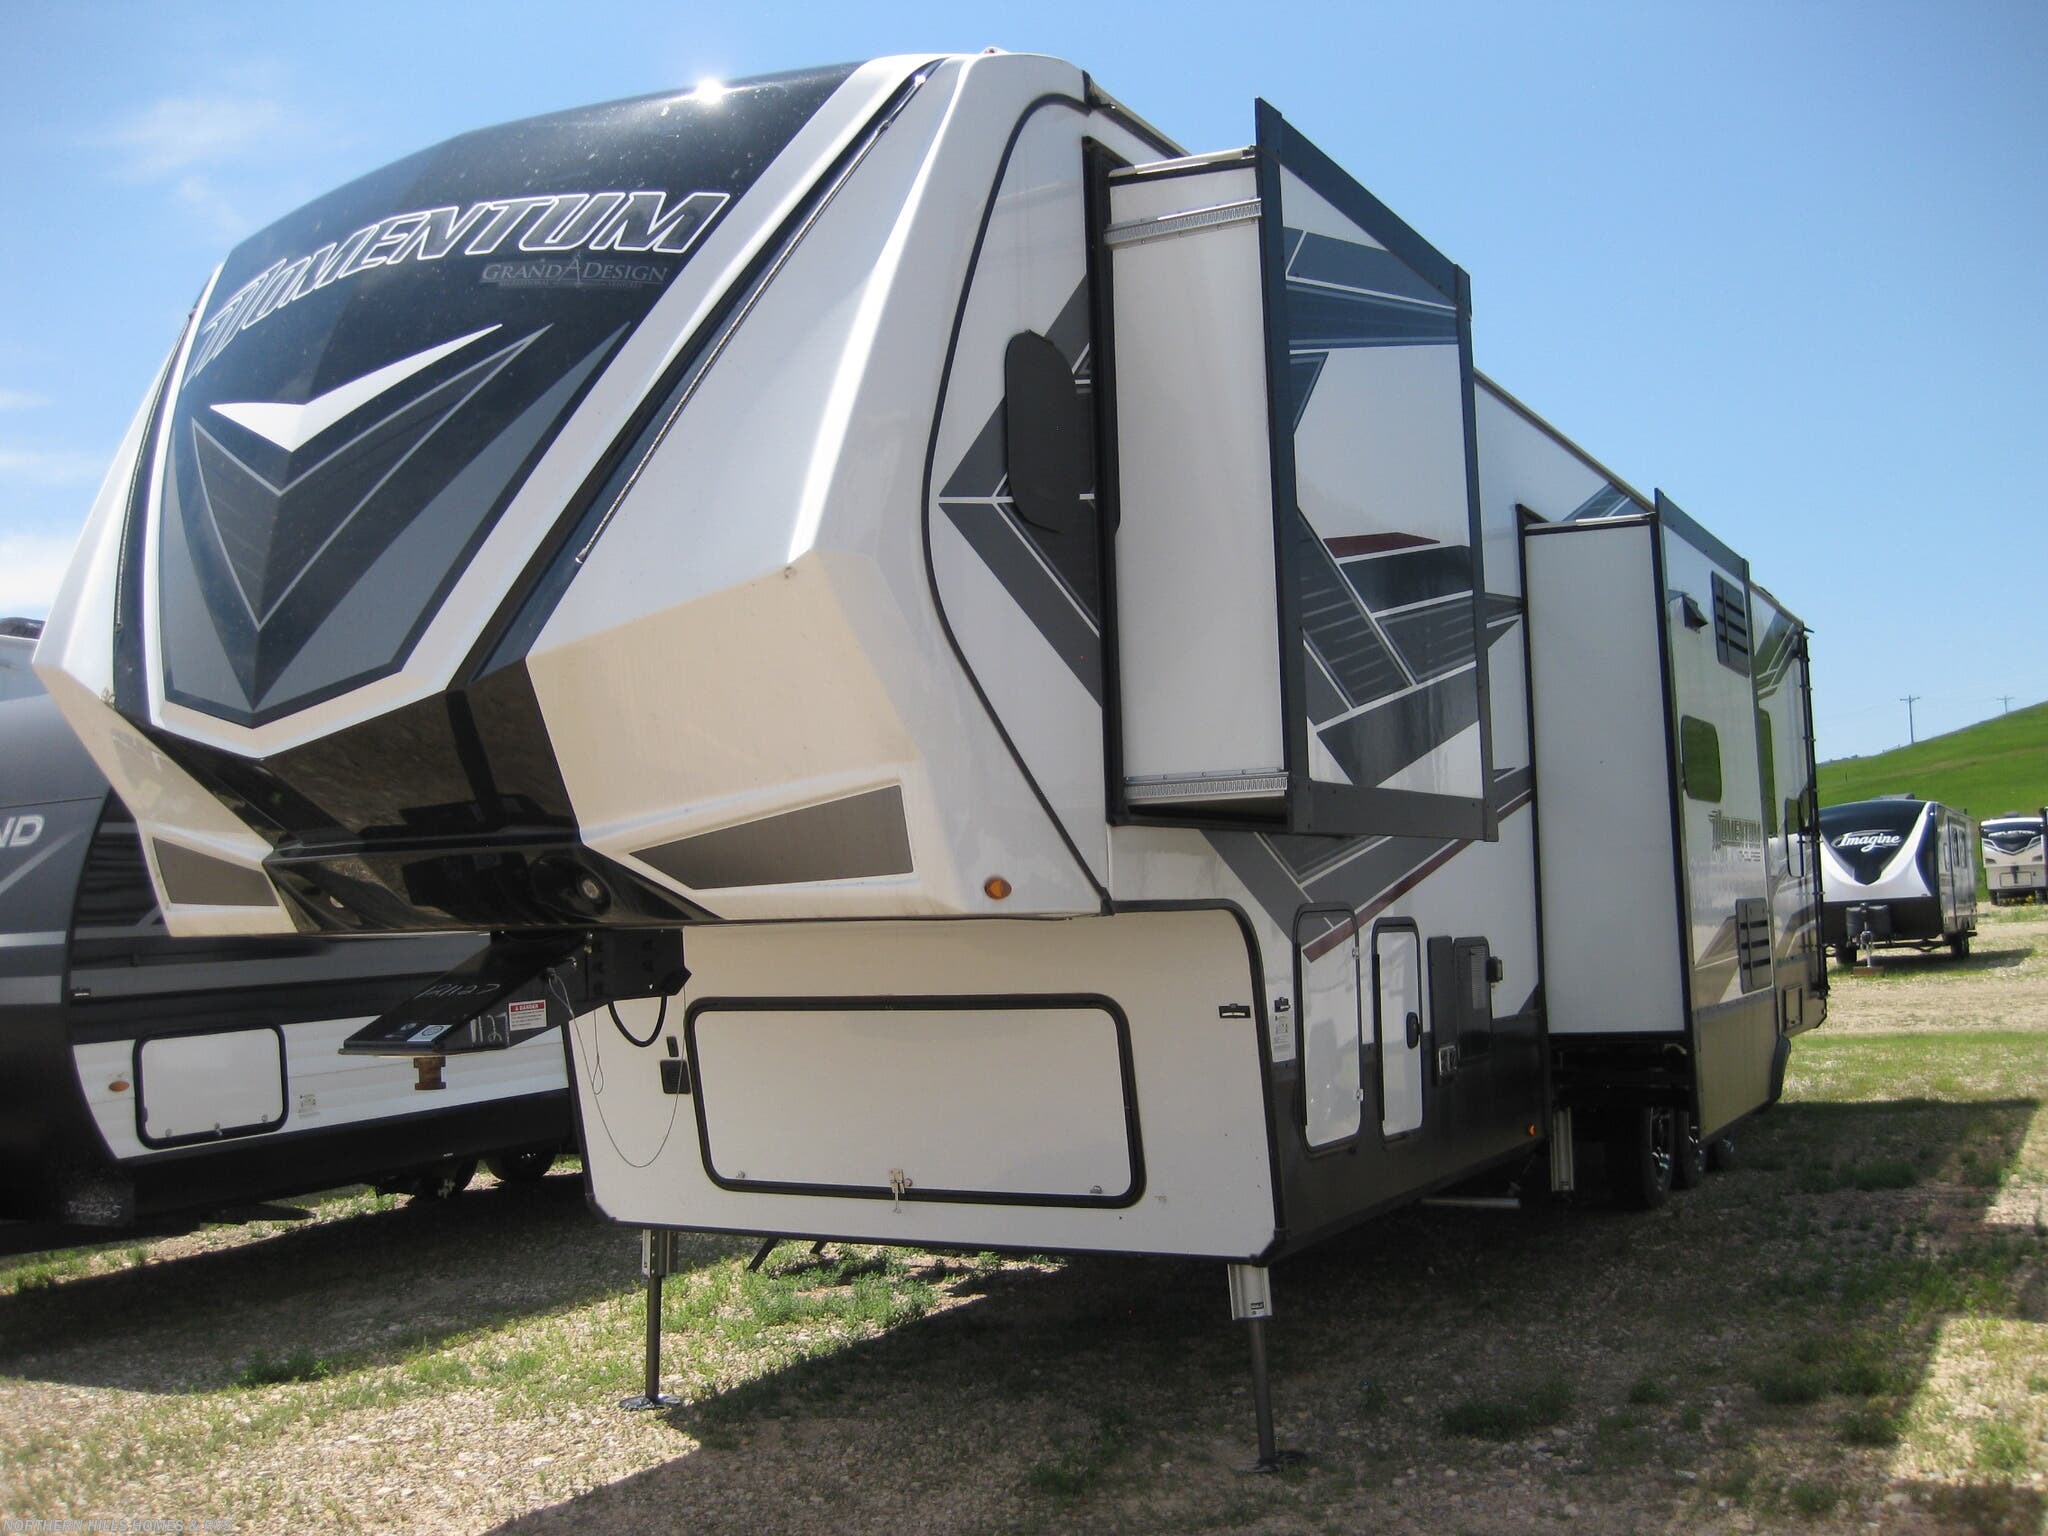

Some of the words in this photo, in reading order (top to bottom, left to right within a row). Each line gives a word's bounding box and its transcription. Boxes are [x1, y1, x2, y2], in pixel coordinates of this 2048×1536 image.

[482, 263, 563, 281] GRAND
[582, 261, 669, 282] DESIGN
[182, 191, 731, 389] MOMENTUM
[1838, 831, 1901, 853] Imagine
